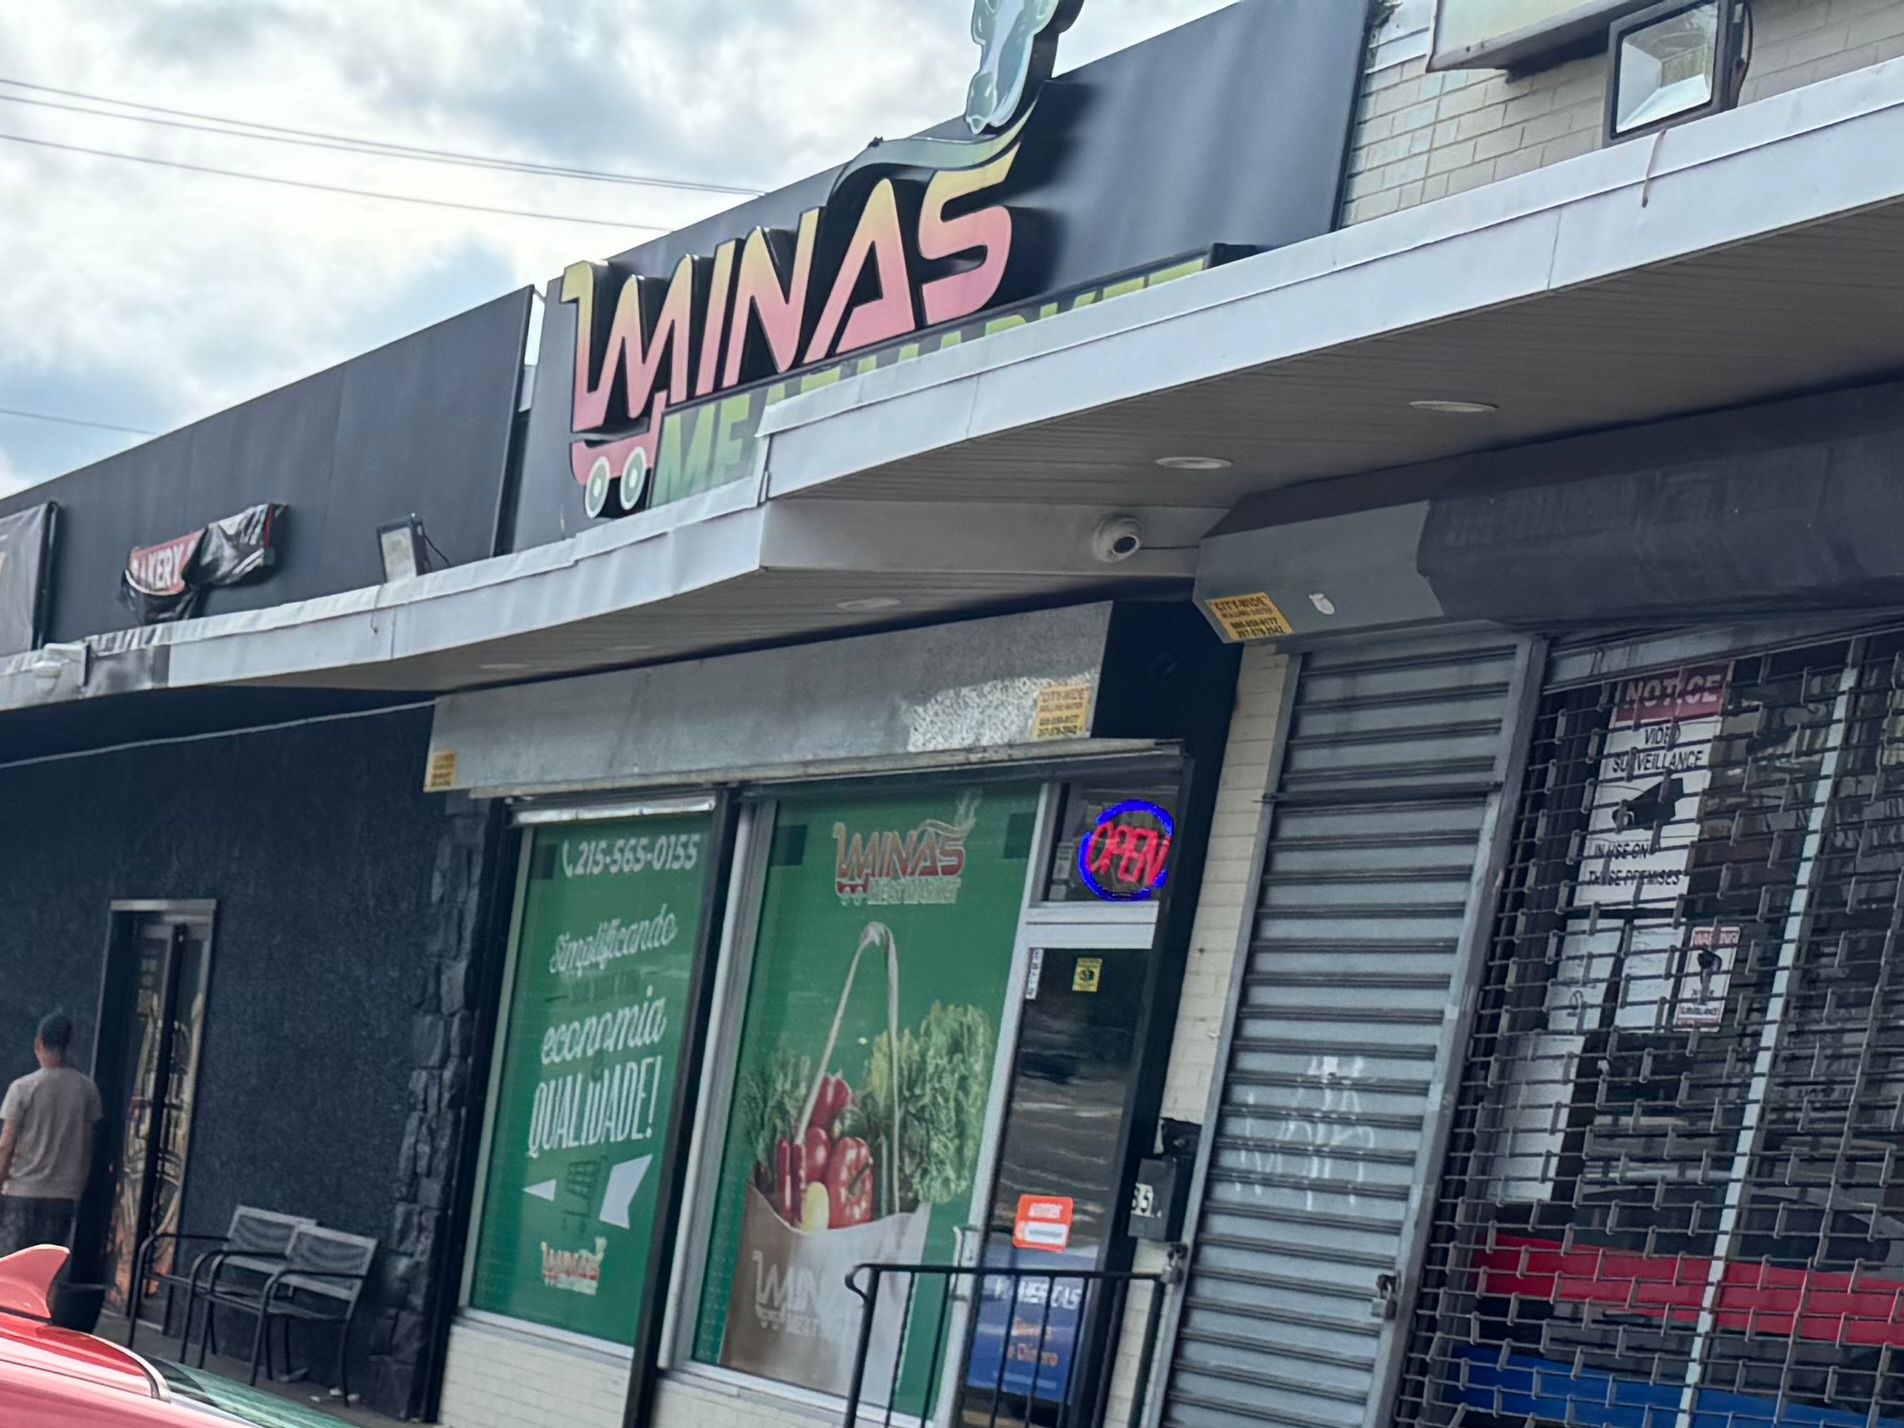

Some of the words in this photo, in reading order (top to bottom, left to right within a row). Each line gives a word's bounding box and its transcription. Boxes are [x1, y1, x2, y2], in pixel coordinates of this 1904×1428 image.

[561, 142, 1021, 433] MINAS
[1623, 674, 1723, 709] NOTICE
[1613, 750, 1704, 774] SUVEILLANCE
[575, 834, 701, 876] 215-565-0155
[832, 821, 967, 880] MINAS
[1086, 821, 1173, 887] OPEN
[549, 903, 678, 978] Simplificando
[541, 984, 667, 1065] economia
